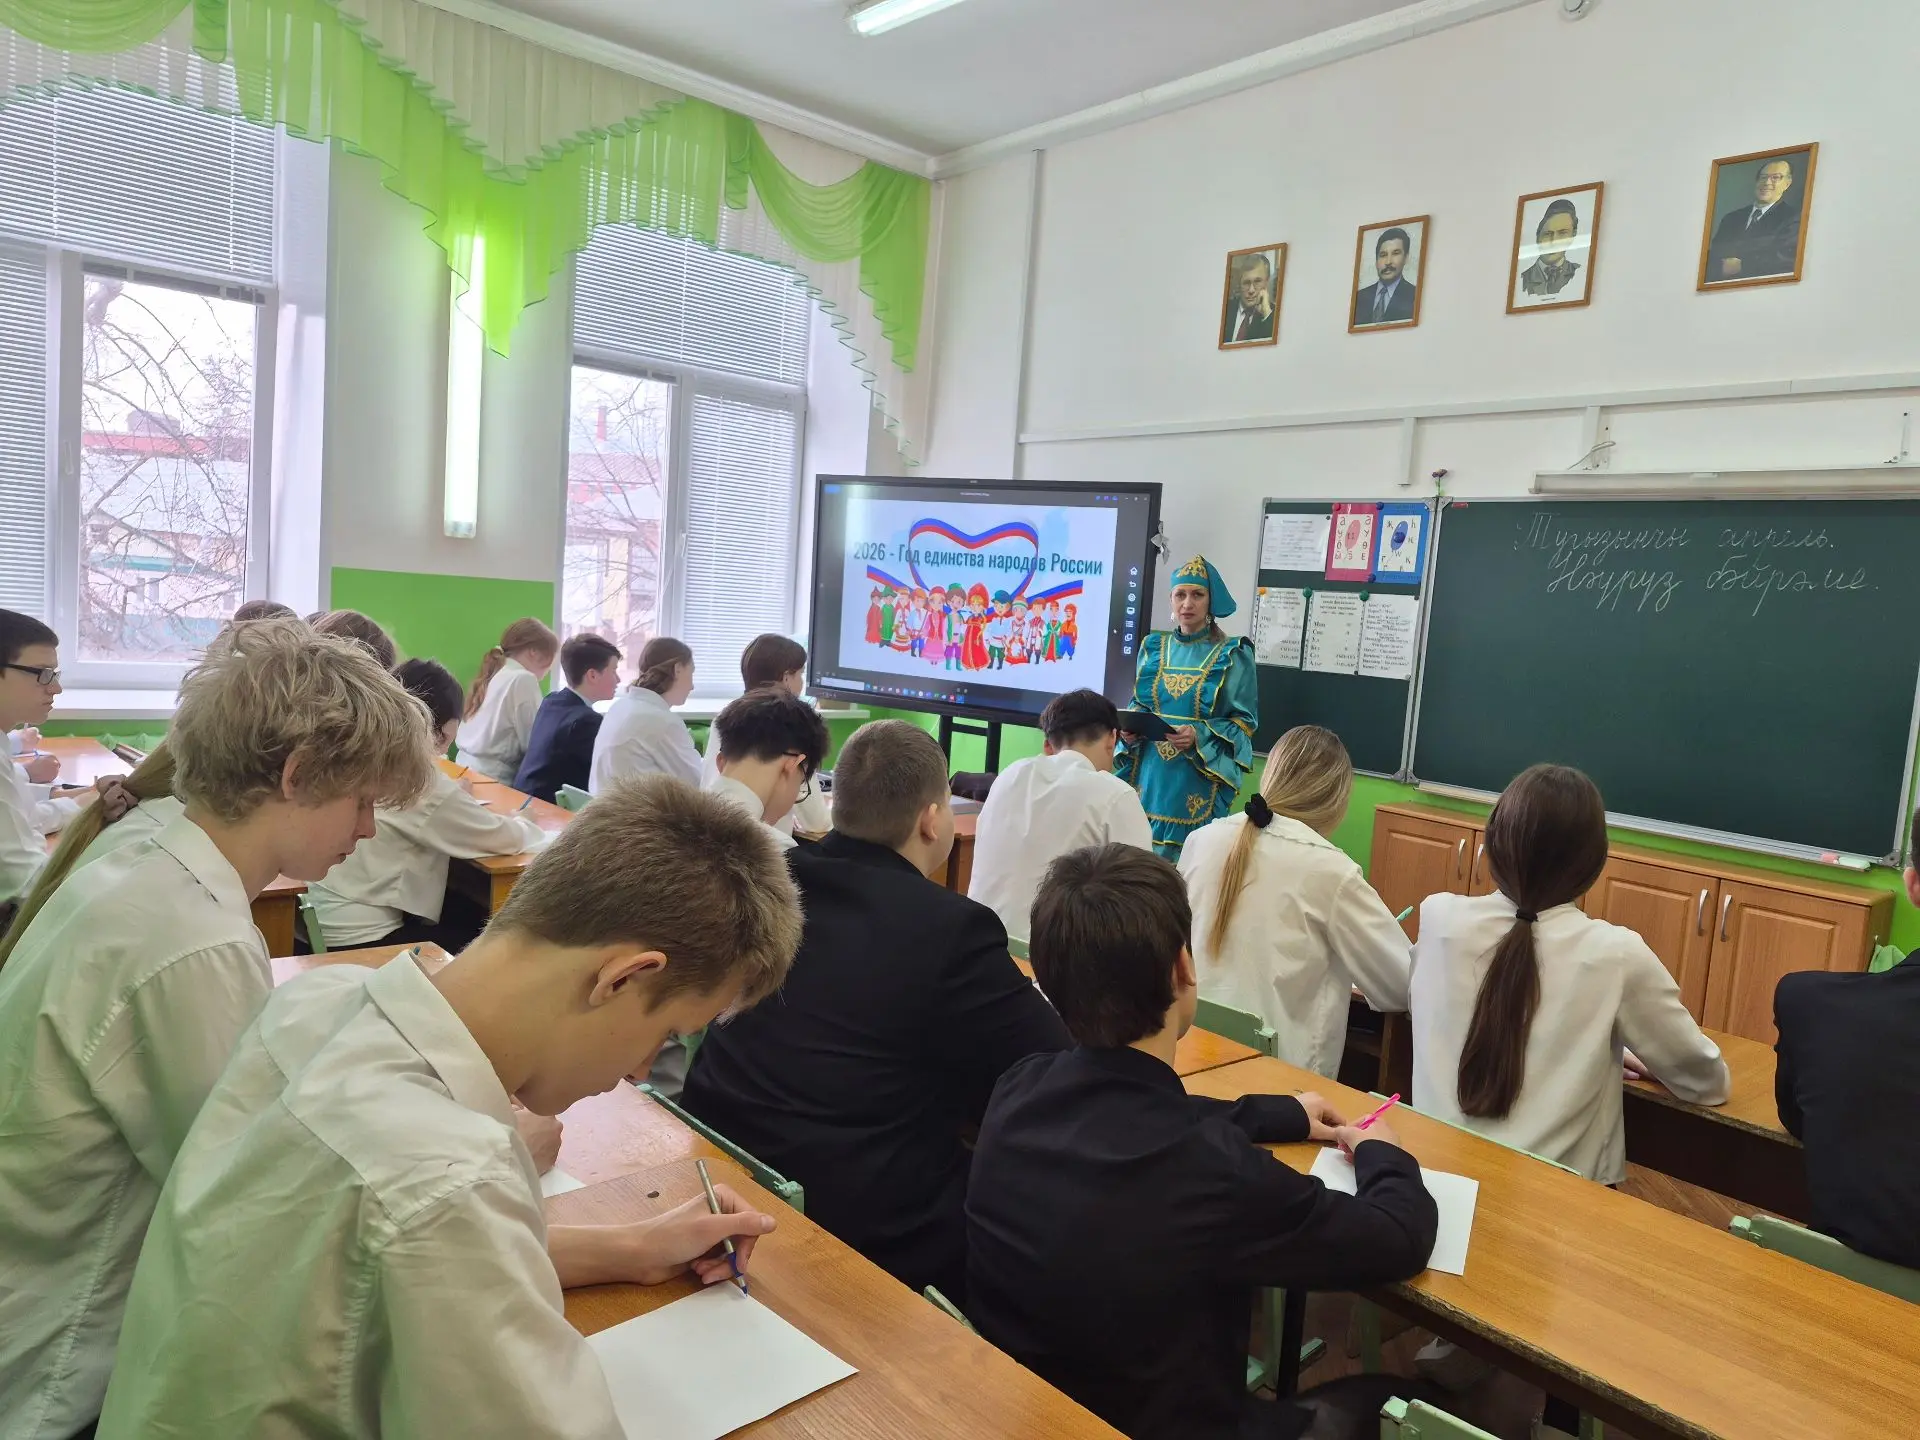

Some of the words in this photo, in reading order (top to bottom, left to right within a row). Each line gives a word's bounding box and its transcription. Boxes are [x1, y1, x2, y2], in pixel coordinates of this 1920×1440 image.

[854, 542, 886, 561] 2026
[898, 544, 921, 566] Год
[924, 550, 985, 568] единства
[988, 554, 1046, 574] народов
[1050, 553, 1103, 575] России
